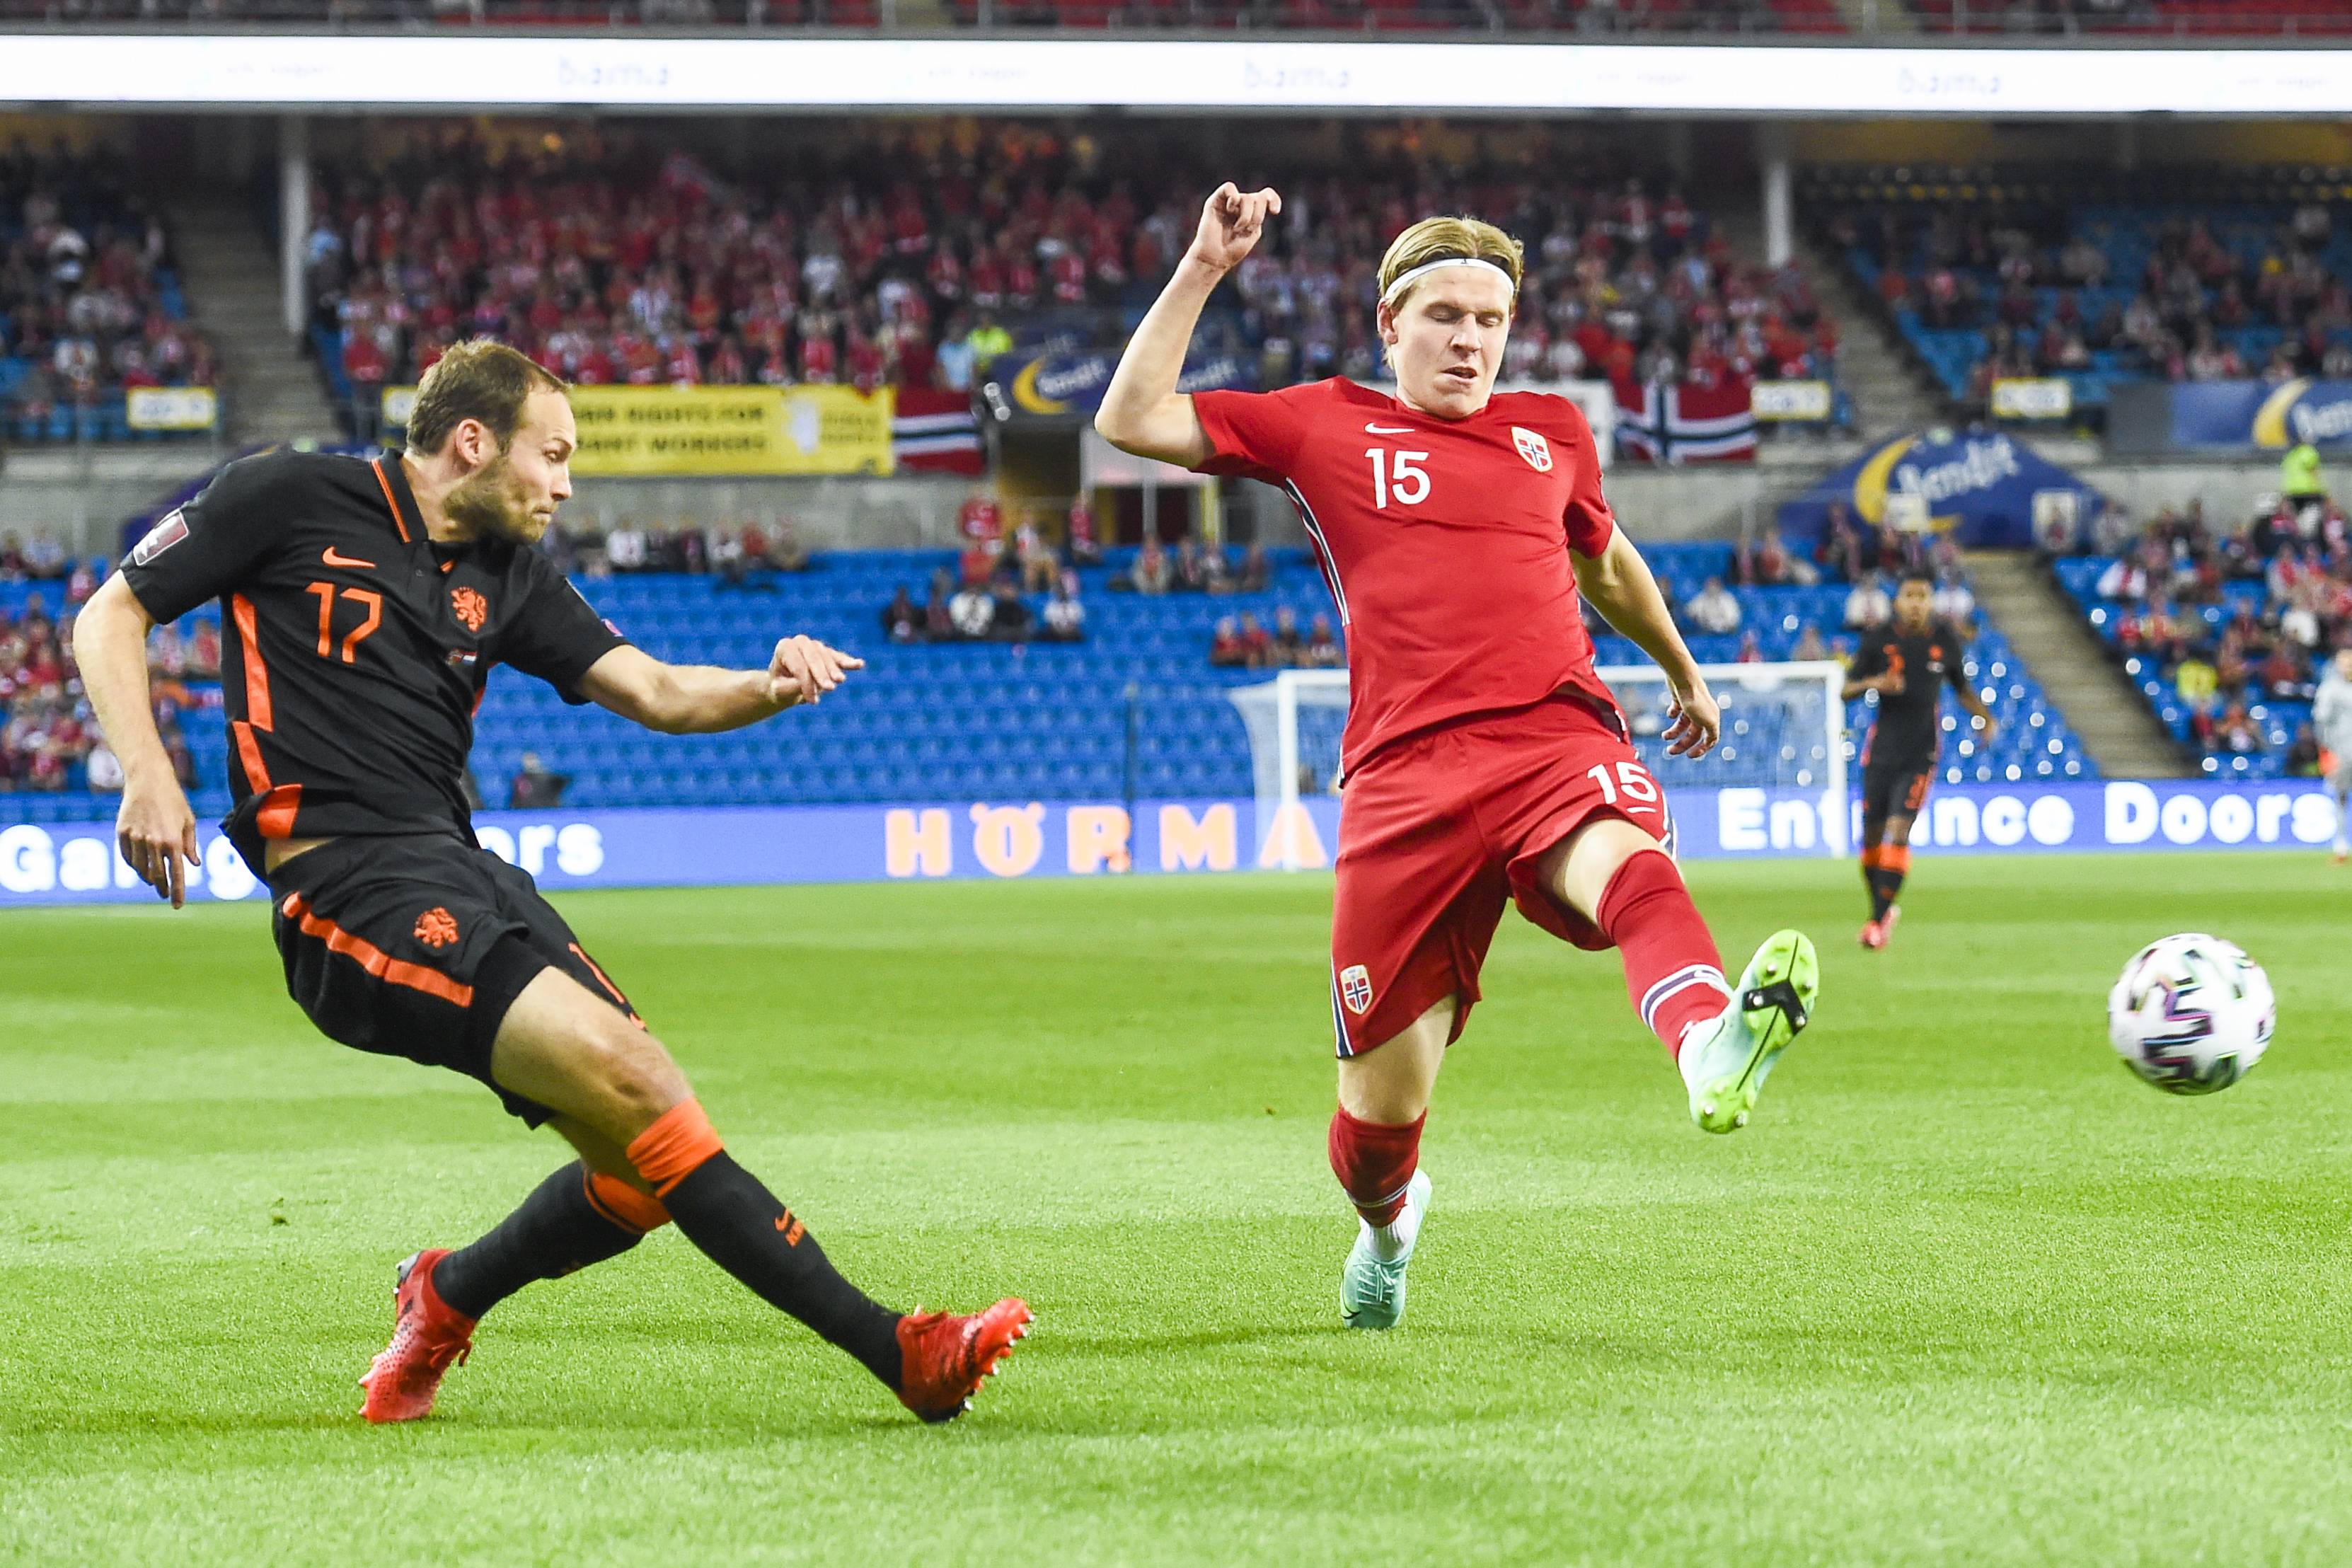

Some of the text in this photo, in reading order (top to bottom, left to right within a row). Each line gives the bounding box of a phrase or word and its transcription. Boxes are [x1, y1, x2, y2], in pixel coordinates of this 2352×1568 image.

[1364, 448, 1431, 509] 15
[305, 581, 382, 663] 17
[1586, 761, 1658, 805] 15
[2104, 780, 2337, 846] Doors
